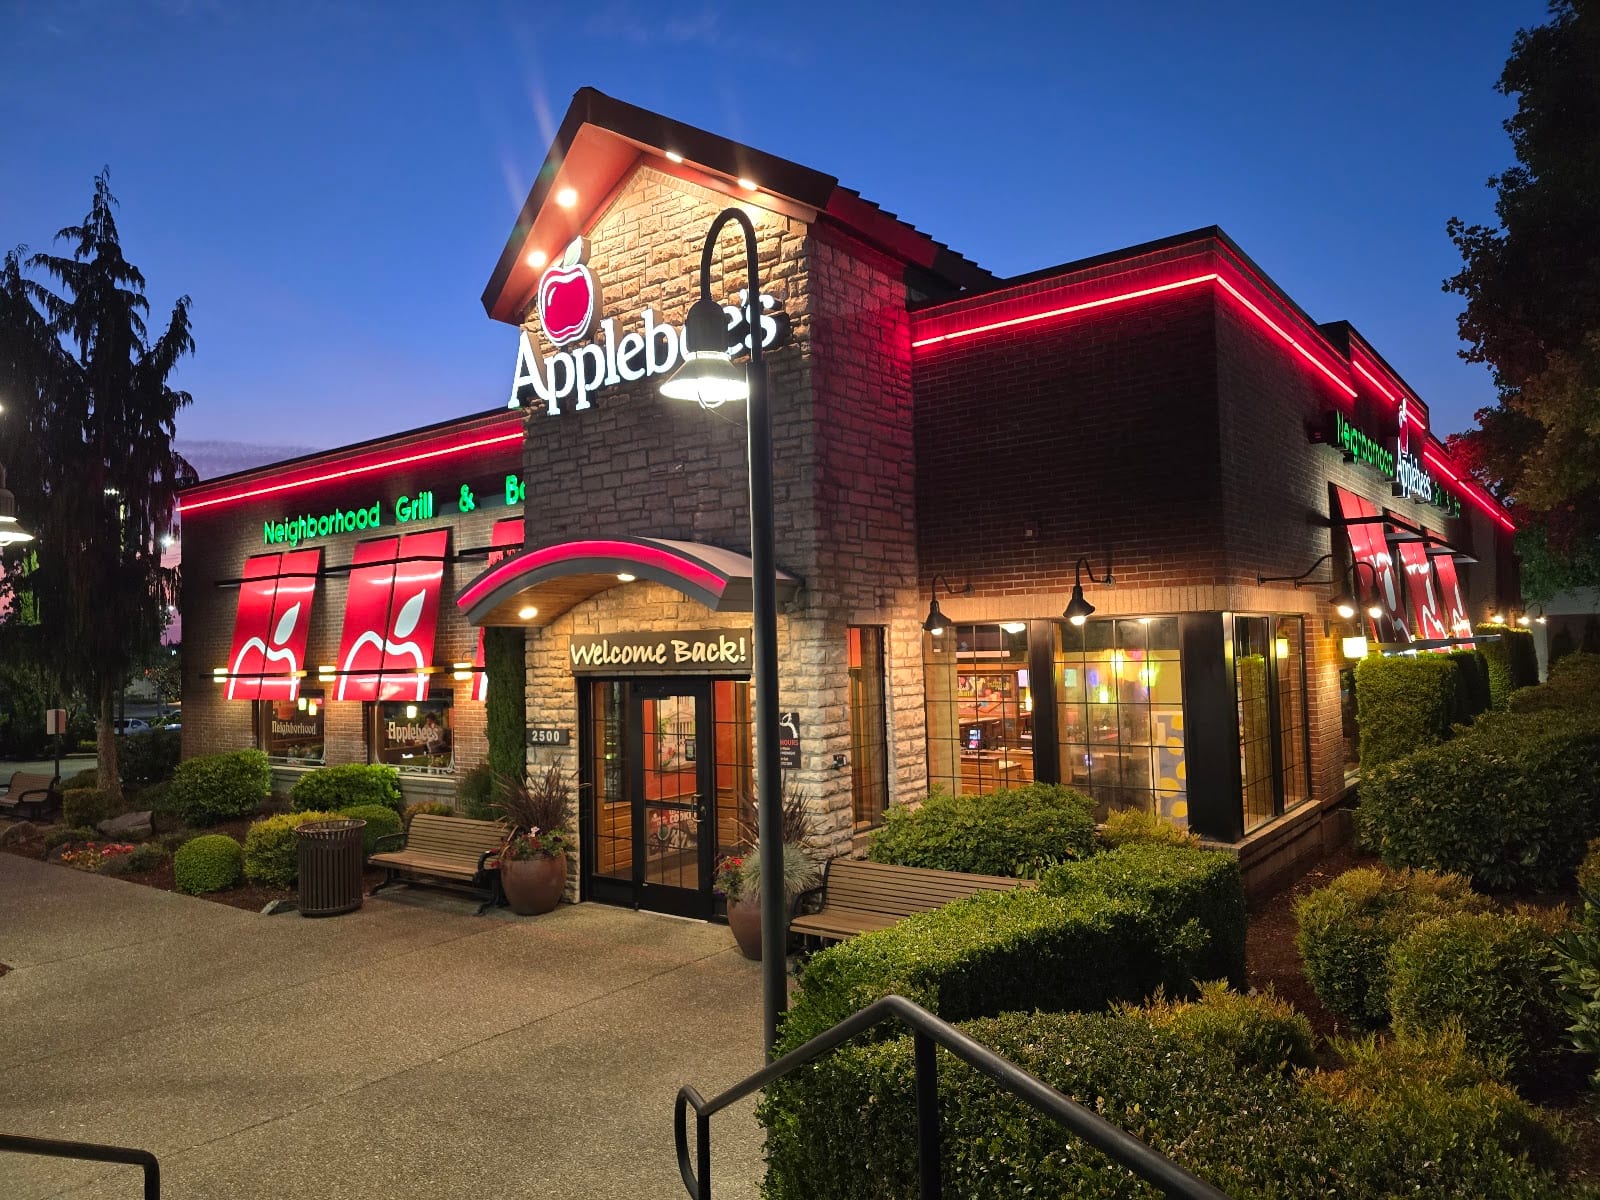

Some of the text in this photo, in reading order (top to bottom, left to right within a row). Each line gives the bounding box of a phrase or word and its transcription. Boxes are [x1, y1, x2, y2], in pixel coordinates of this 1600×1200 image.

[508, 289, 776, 415] Applebe's
[264, 501, 380, 547] Neighborhood
[396, 491, 433, 522] Grill
[459, 484, 475, 512] &
[570, 635, 746, 665] Welcome Back!
[272, 720, 316, 735] Neighborhood
[532, 730, 559, 742] 2500
